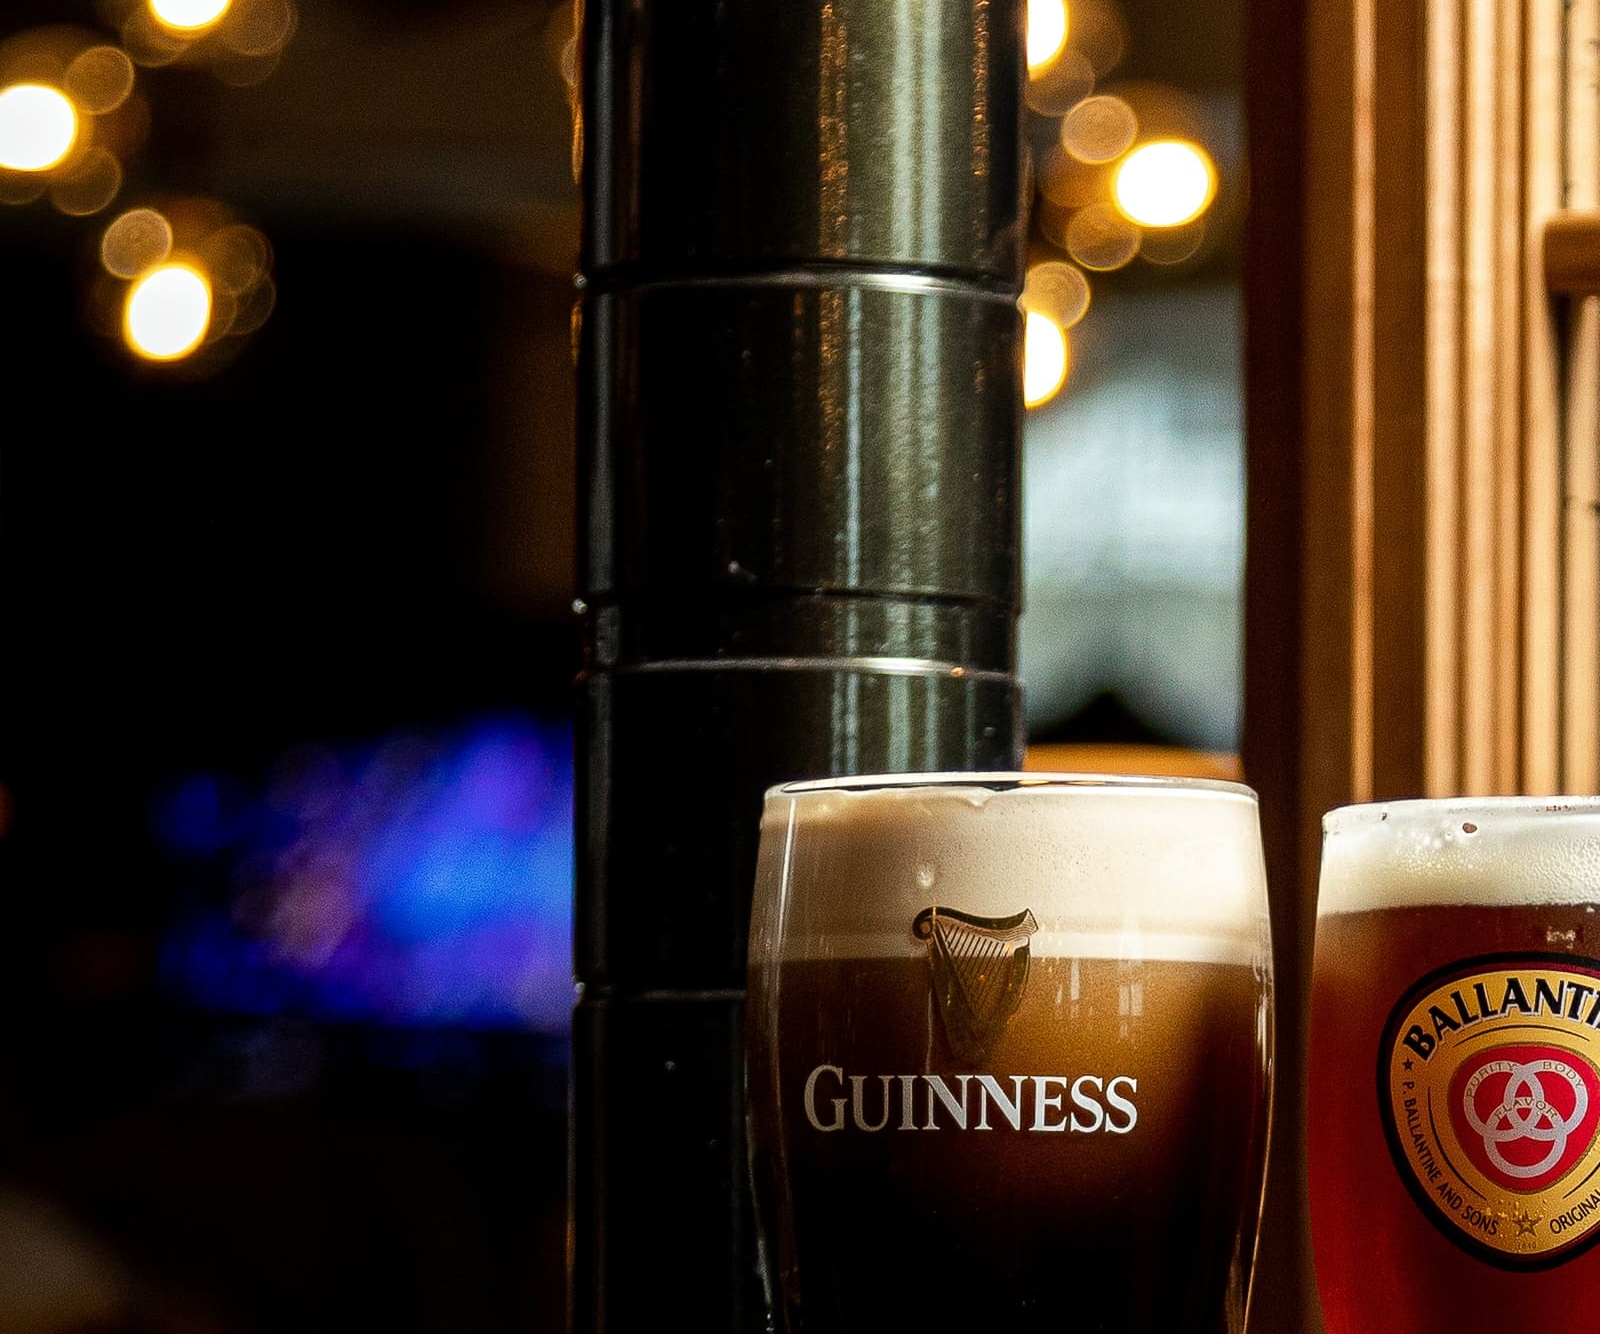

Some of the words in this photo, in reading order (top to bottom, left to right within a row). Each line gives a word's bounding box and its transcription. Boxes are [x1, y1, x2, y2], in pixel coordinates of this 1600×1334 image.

[804, 1064, 1139, 1133] GUINNESS
[1542, 1061, 1585, 1088] BODY
[1494, 1097, 1559, 1120] FLAVOR
[1404, 1097, 1443, 1184] BALLANTINE
[1436, 1182, 1463, 1210] AND
[1461, 1205, 1500, 1236] SONS
